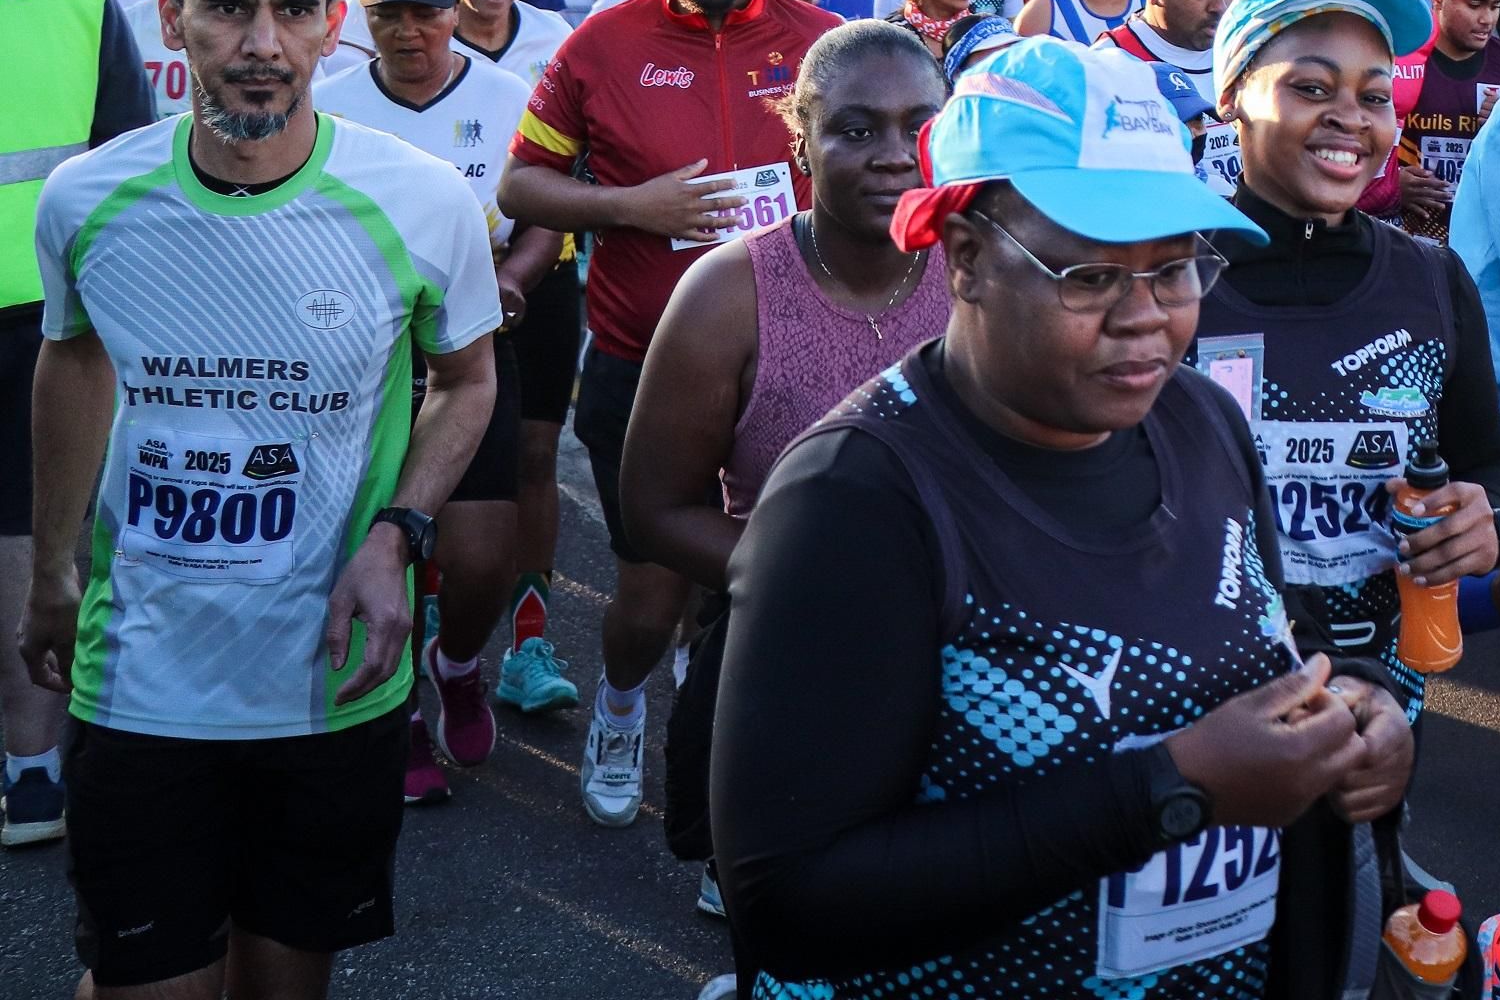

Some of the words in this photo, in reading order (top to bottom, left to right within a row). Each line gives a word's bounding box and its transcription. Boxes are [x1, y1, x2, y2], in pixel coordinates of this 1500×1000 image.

[144, 60, 187, 101] 70
[640, 62, 694, 88] Lewis
[748, 86, 782, 98] BUSINESS
[1407, 113, 1452, 132] Kuils
[1445, 142, 1463, 154] 2025
[464, 163, 486, 178] AC
[1330, 327, 1413, 377] TOPFORM
[142, 356, 310, 382] WALMERS
[123, 381, 259, 410] THLETIC
[268, 390, 350, 415] CLUB
[145, 438, 168, 450] ASA
[185, 449, 232, 475] 2025
[250, 447, 294, 466] ASA
[1286, 437, 1334, 464] 2025
[1354, 434, 1395, 454] ASA
[127, 472, 297, 545] P9800
[1214, 517, 1243, 610] TOPFORM
